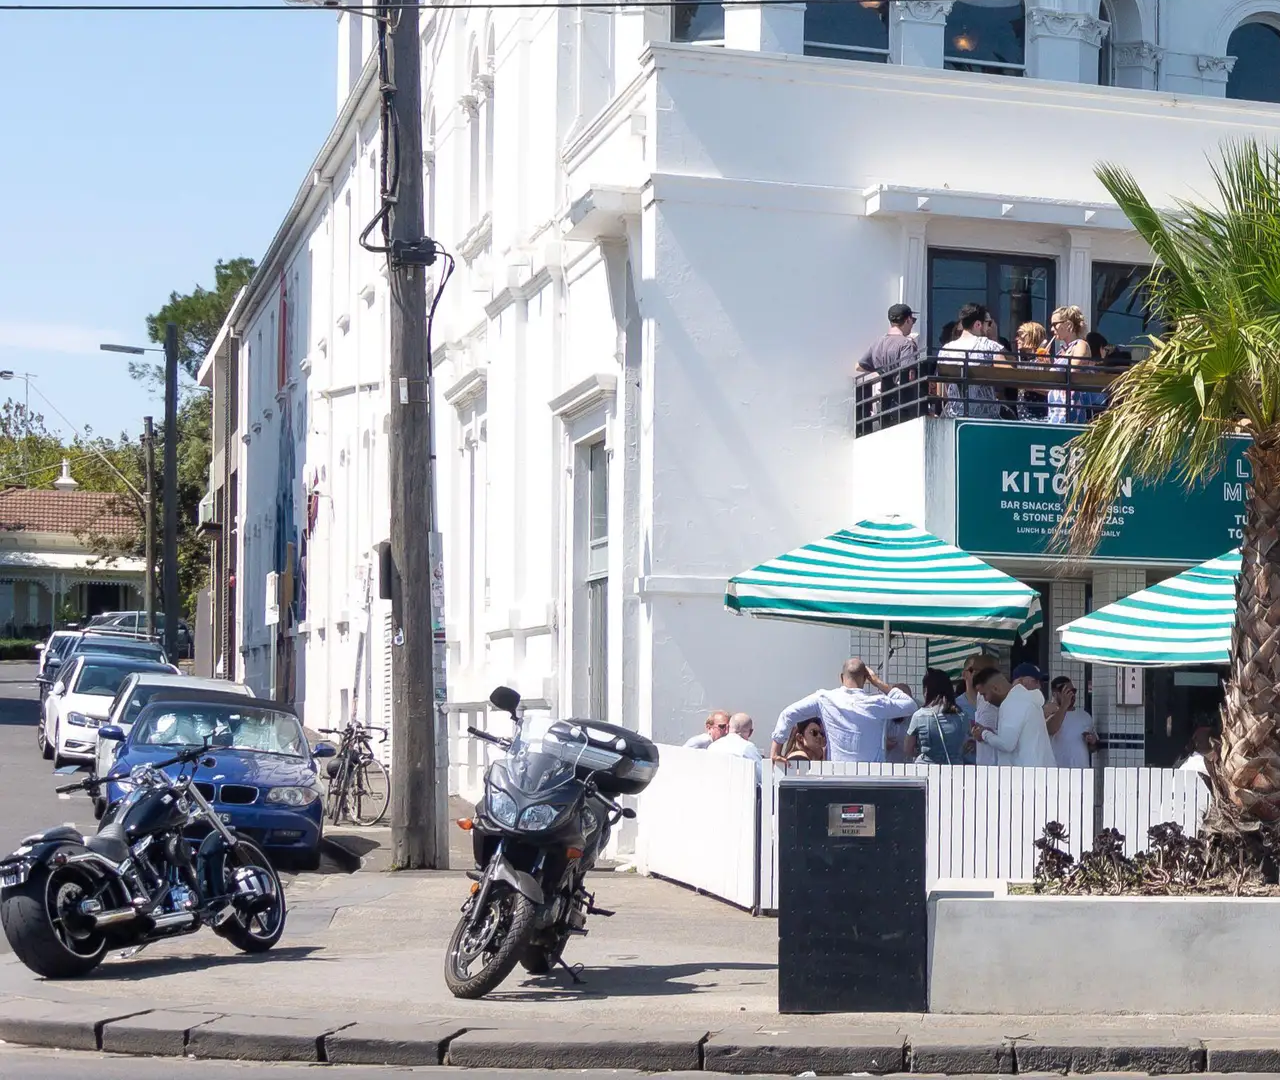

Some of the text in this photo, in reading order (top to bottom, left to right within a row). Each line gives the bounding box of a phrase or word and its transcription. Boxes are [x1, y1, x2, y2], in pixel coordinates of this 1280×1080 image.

[1000, 500, 1020, 509] BAR
[1022, 501, 1064, 512] SNACKS,
[1013, 512, 1020, 521] &
[1022, 513, 1054, 522] STONE
